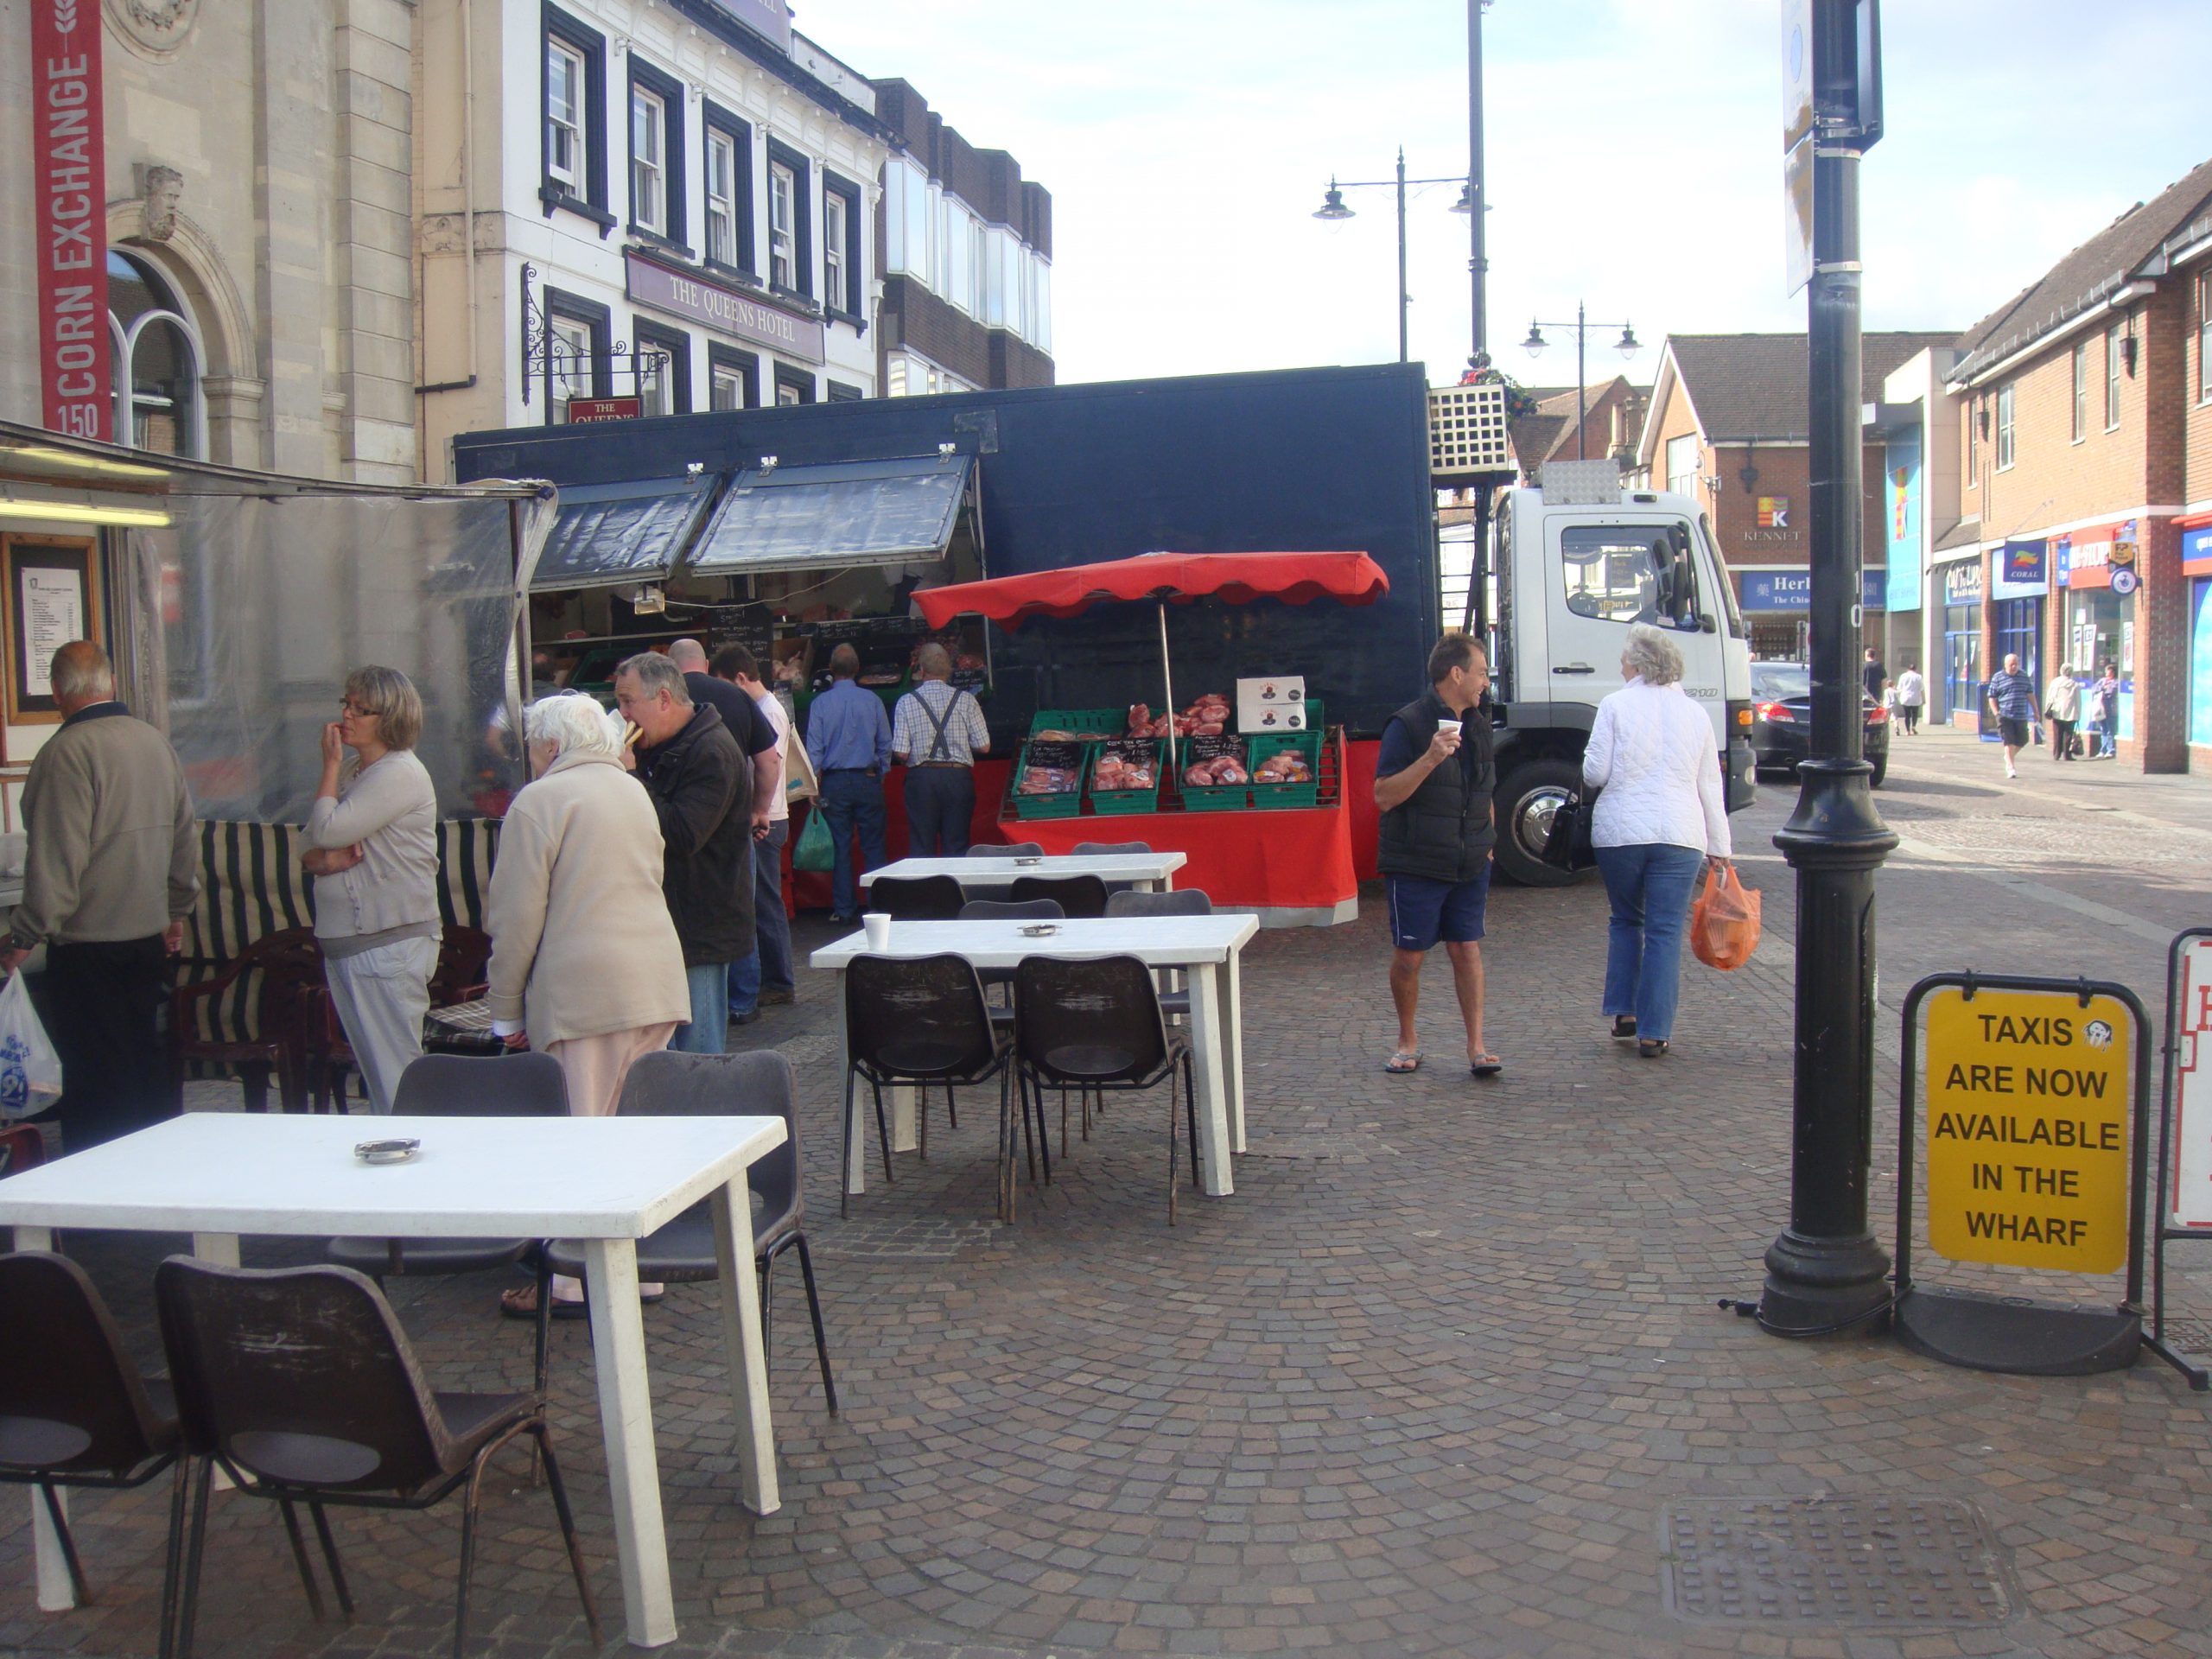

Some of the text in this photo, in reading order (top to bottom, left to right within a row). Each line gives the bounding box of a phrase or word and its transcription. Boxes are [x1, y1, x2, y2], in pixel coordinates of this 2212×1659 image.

[48, 54, 96, 397] CORN EXCHANGE
[671, 276, 795, 342] THE QUEENS HOTEL
[58, 404, 99, 438] 150
[594, 404, 615, 412] THE
[1744, 531, 1801, 541] KENNET
[1978, 1014, 2073, 1046] TAXIS
[1945, 1064, 2107, 1099] ARE NOW
[1935, 1112, 2120, 1151] AVAILABLE
[1973, 1163, 2079, 1198] IN THE
[1965, 1211, 2088, 1247] WHARF
